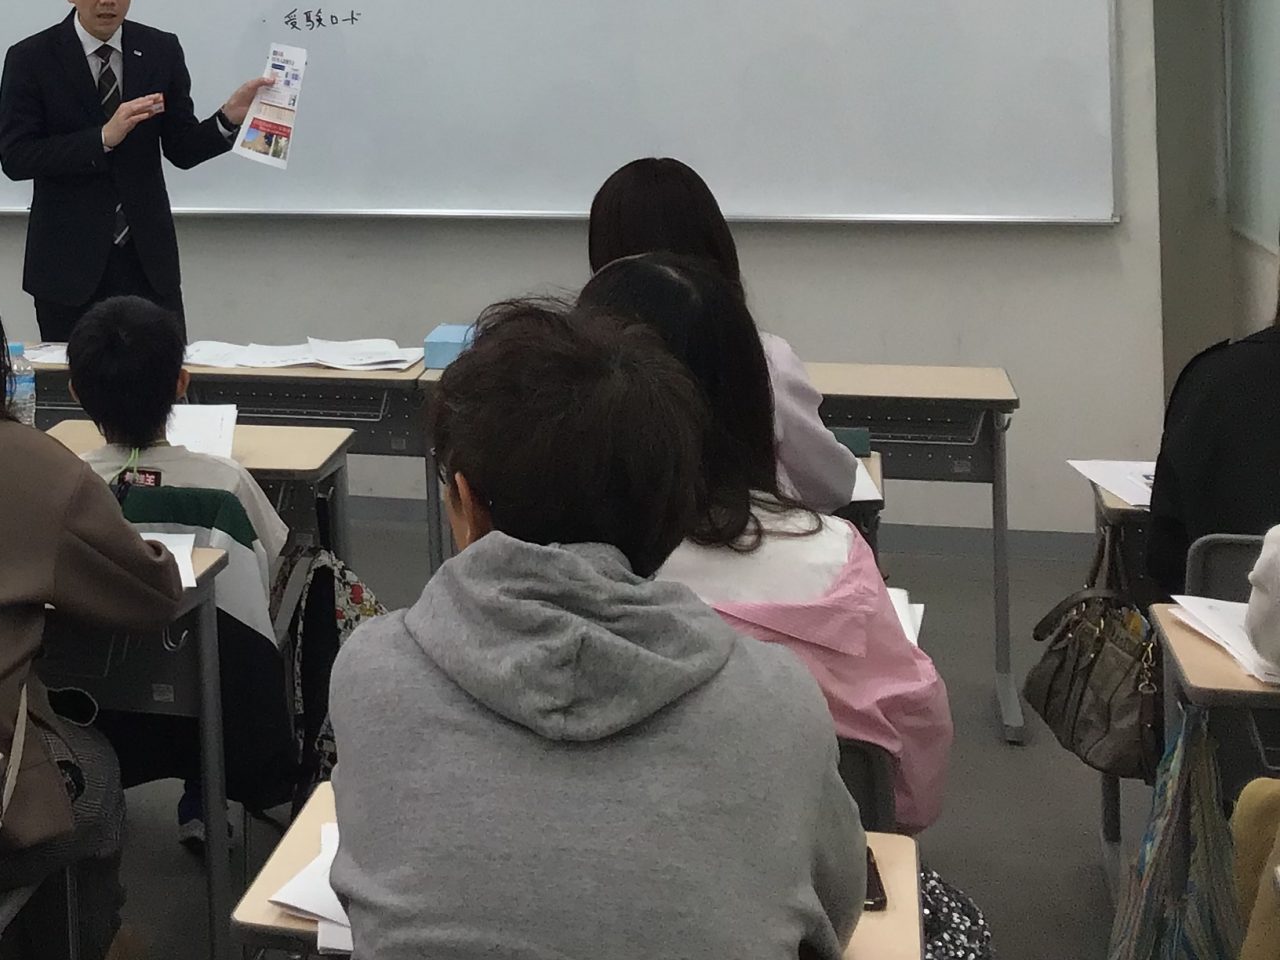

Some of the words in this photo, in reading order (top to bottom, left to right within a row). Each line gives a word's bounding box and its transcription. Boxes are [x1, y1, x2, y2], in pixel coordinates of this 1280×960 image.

[284, 8, 361, 31] 受験ロード
